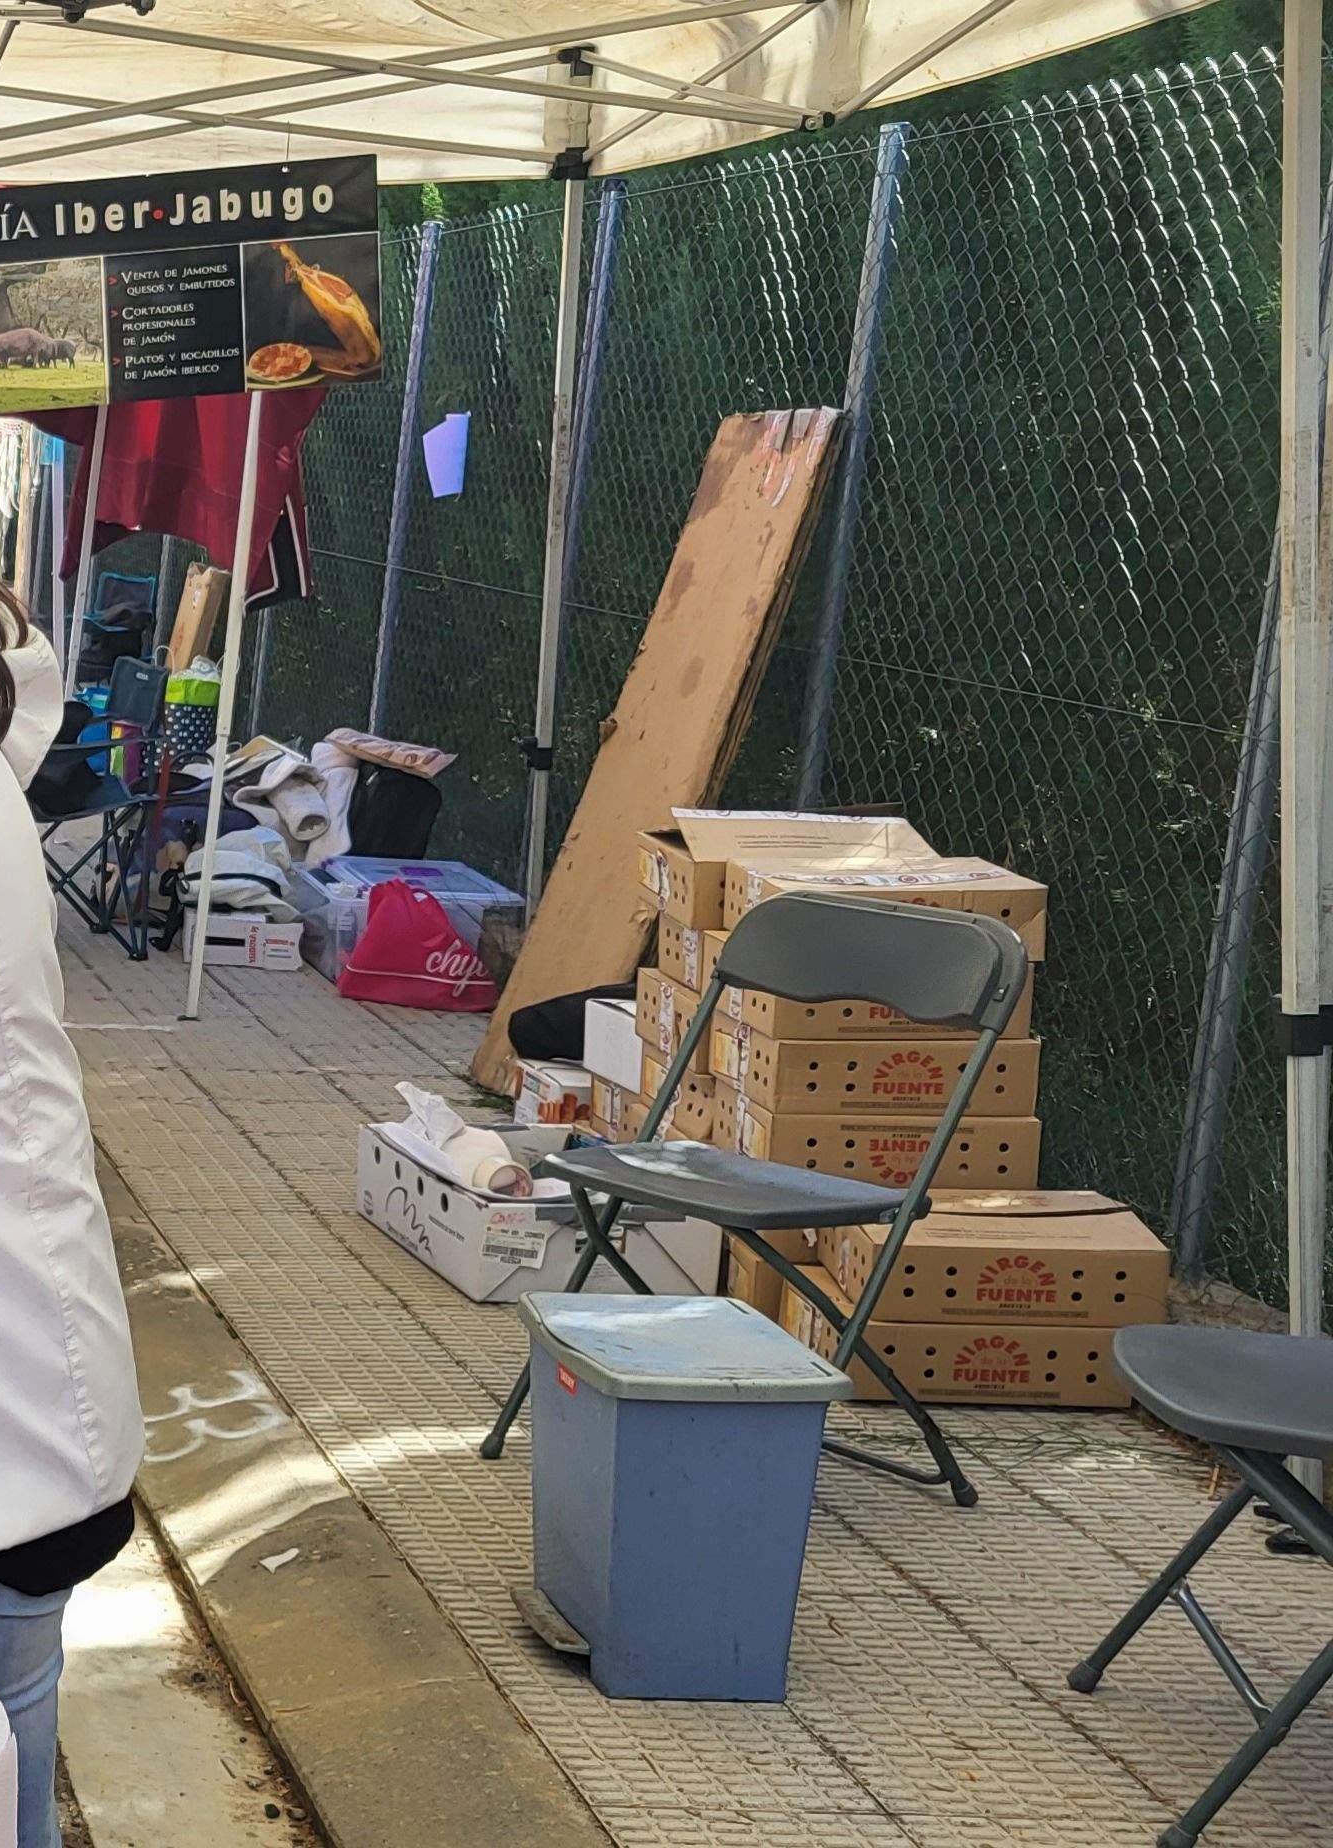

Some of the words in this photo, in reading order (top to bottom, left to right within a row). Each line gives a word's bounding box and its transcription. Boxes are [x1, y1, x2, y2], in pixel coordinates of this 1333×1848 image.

[121, 271, 160, 284] VENTA
[164, 269, 177, 278] DE
[182, 264, 228, 278] JAMONES
[126, 284, 164, 296] QUESOS
[167, 284, 174, 292] Y
[179, 278, 236, 291] EMBUTIDOS
[122, 303, 194, 320] CORTADORES
[122, 318, 196, 331] PROFESIONALES
[123, 337, 136, 346] DE
[140, 332, 175, 346] JAMÓN
[125, 354, 164, 368] PLATOS
[181, 347, 240, 360] BOCADILLOS
[124, 371, 137, 380] DE
[142, 365, 177, 380] JAMÓN
[182, 364, 220, 375] IBERICO
[874, 1051, 943, 1079] VIRGEN
[873, 1082, 944, 1095] FUENTE
[869, 1139, 931, 1152] UENTE
[978, 1255, 1056, 1287] VIRGEN
[976, 1288, 1057, 1303] FUENTE
[954, 1336, 1030, 1367] VIRGEN
[953, 1369, 1030, 1383] FUENTE
